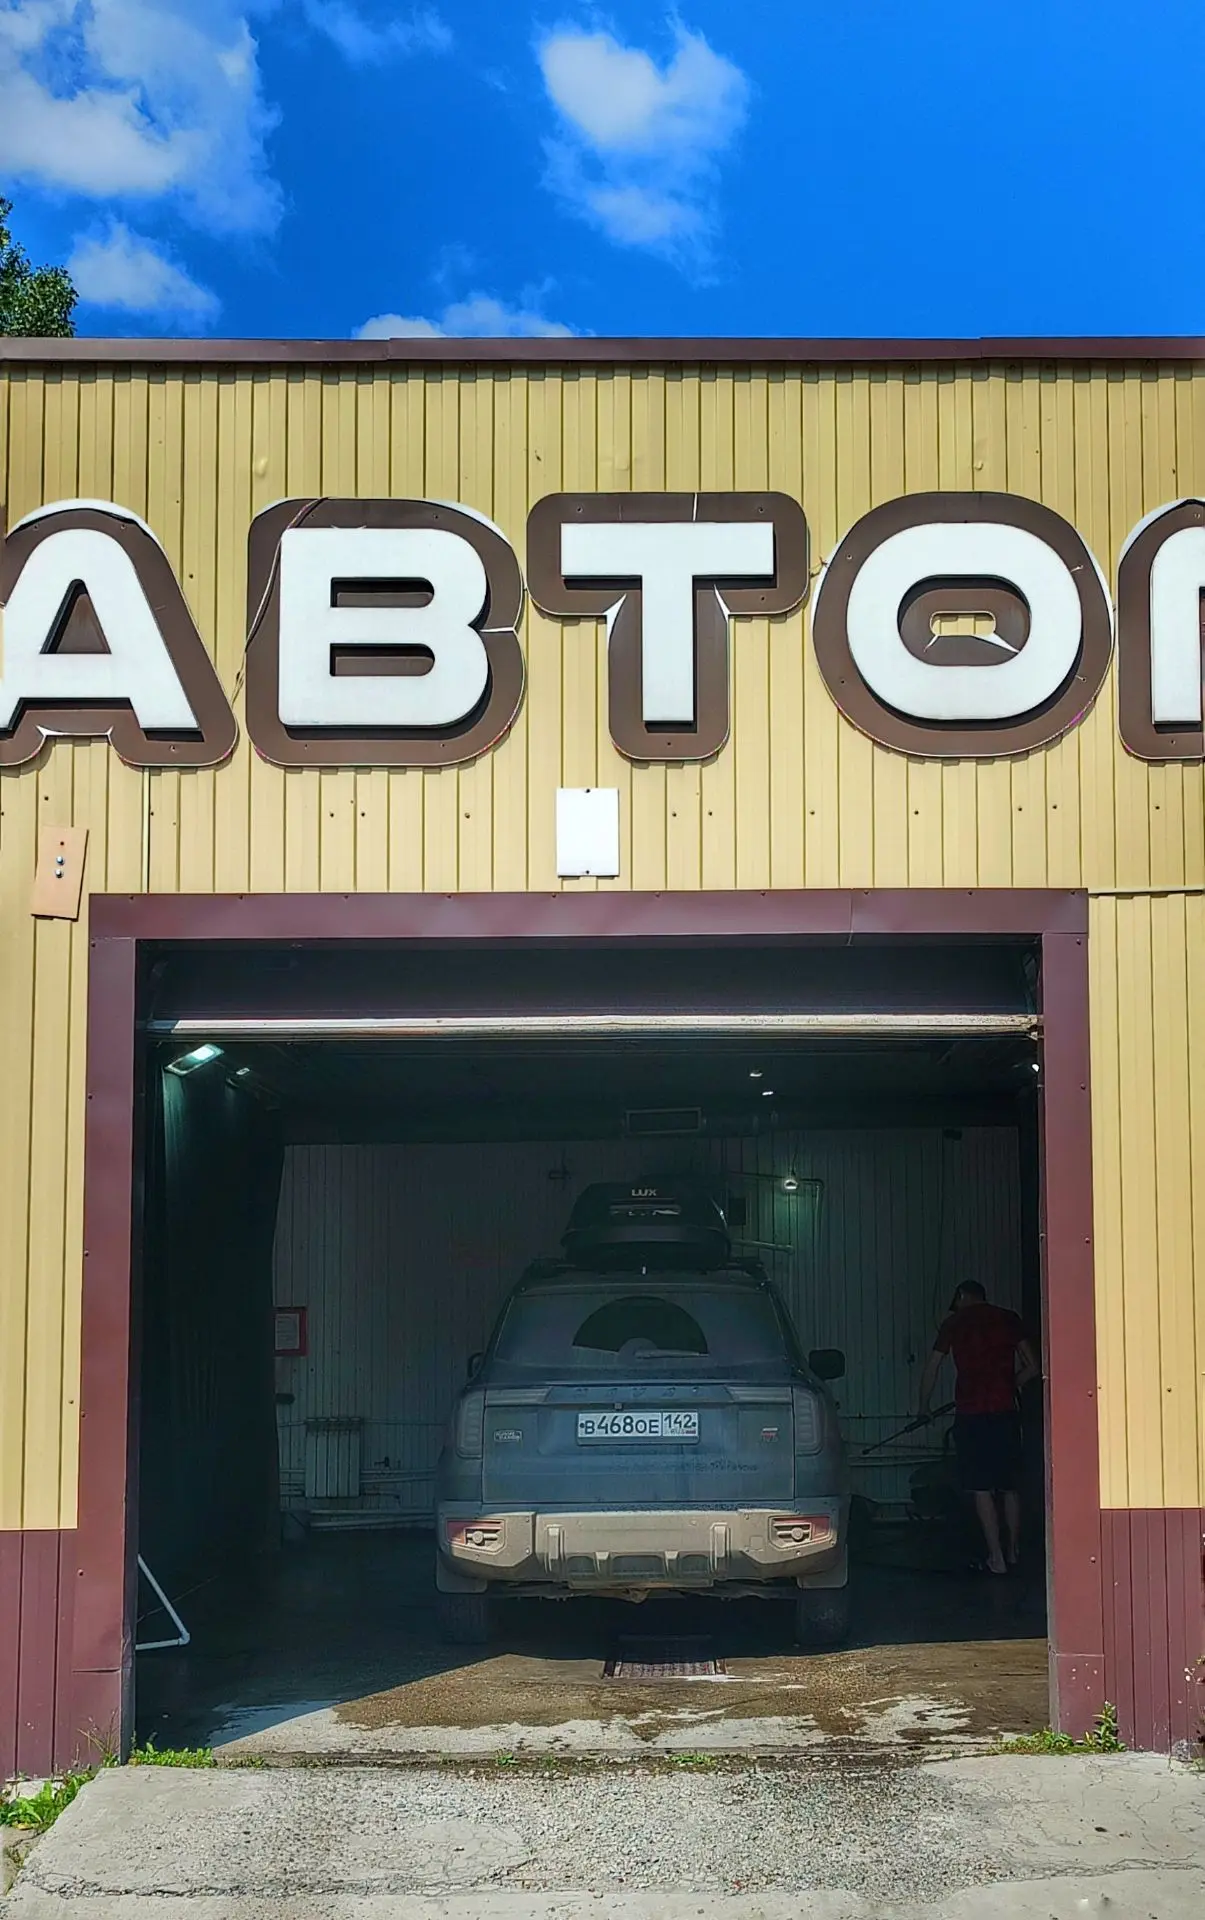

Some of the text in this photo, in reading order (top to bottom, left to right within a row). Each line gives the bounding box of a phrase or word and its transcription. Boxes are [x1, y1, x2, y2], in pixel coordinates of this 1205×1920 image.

[0, 521, 1205, 731] АВТО
[631, 1188, 658, 1197] LUX
[663, 1414, 693, 1429] 142
